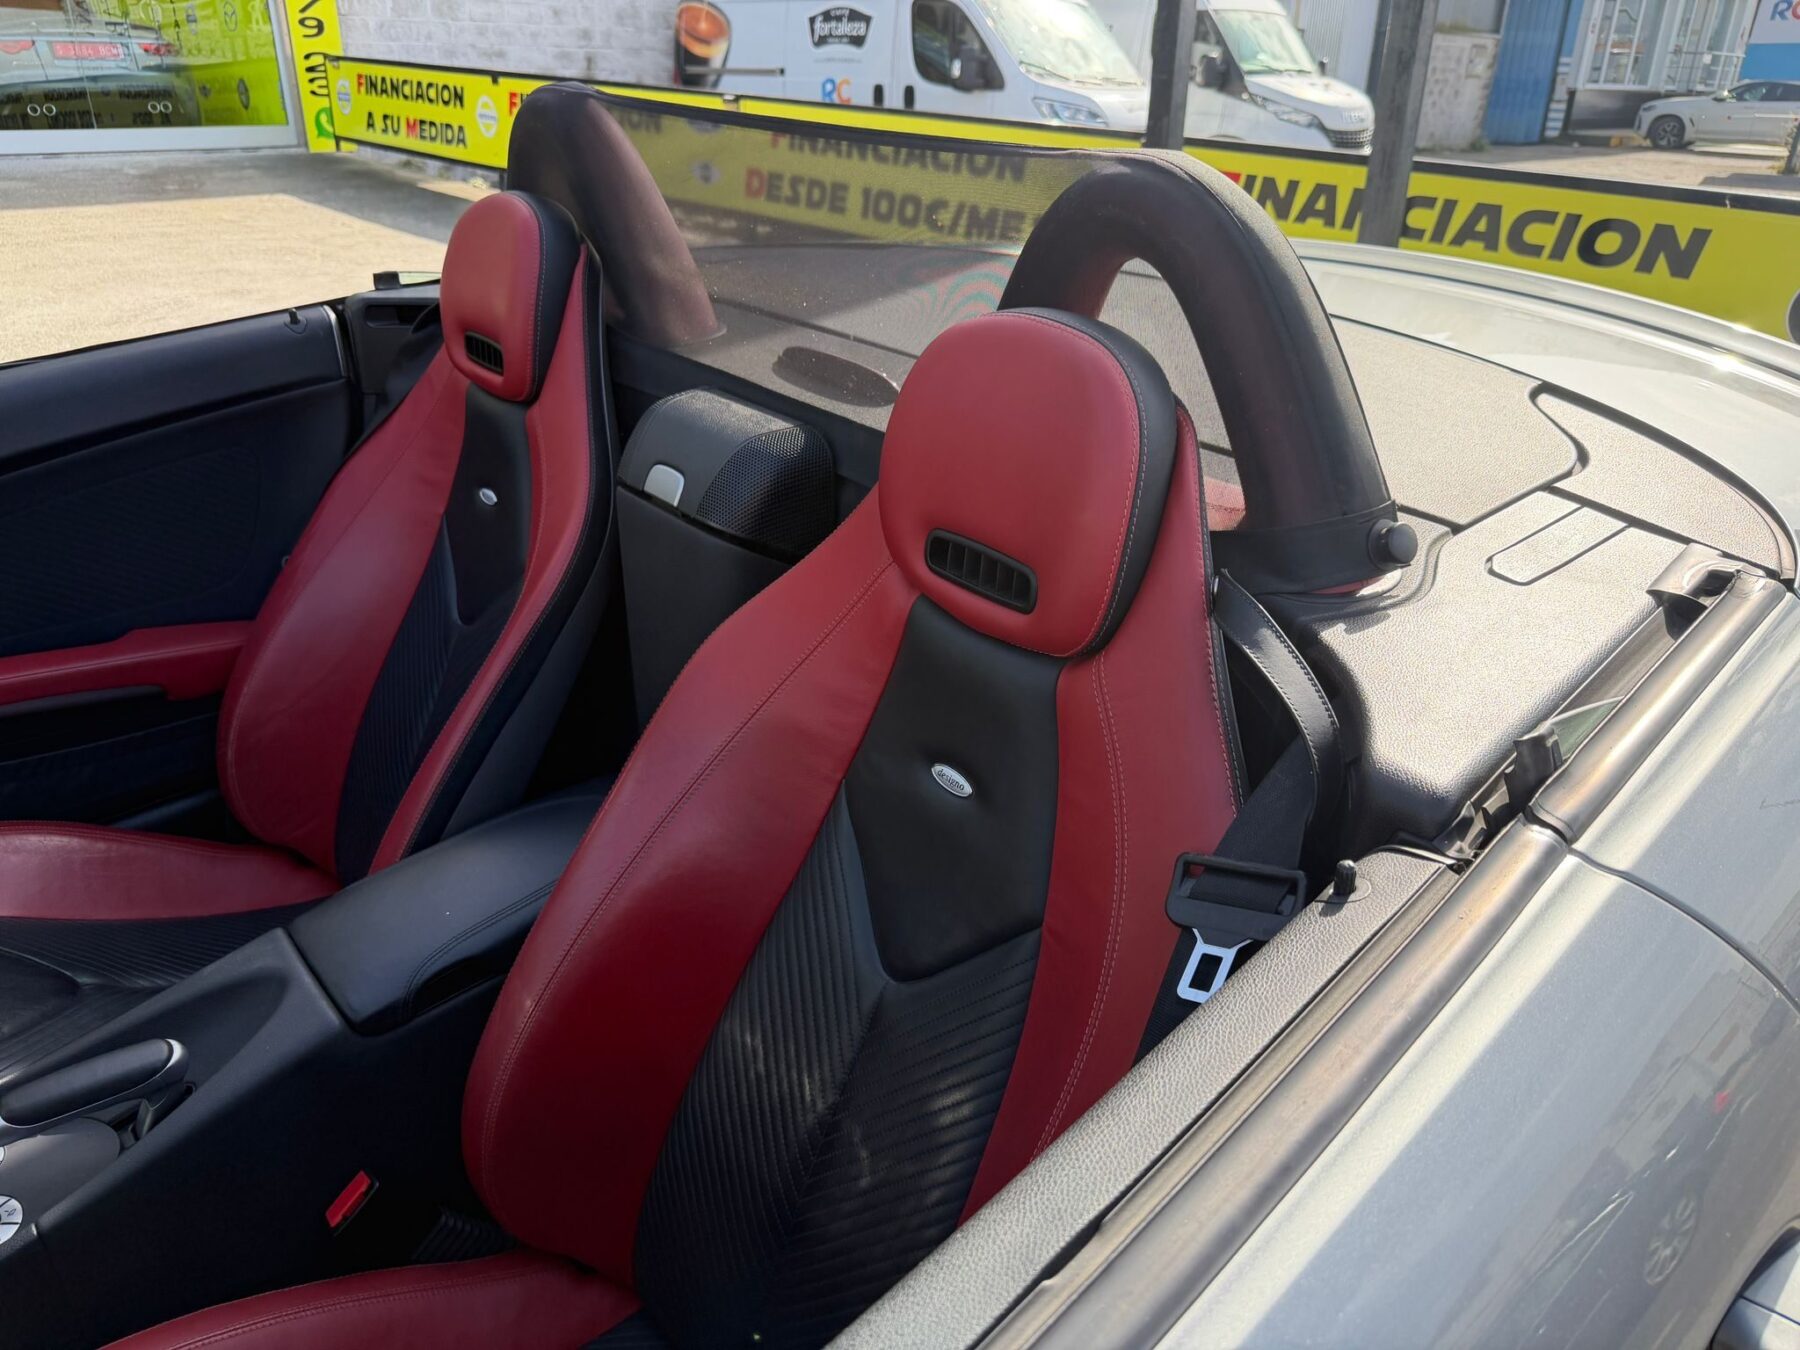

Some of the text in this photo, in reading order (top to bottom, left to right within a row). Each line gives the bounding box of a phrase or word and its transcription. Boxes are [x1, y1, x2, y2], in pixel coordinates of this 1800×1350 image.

[357, 73, 465, 109] FINANCIACION
[367, 111, 467, 149] A SU MEDIDA
[745, 168, 850, 216] DESDE
[937, 768, 965, 791] designo
